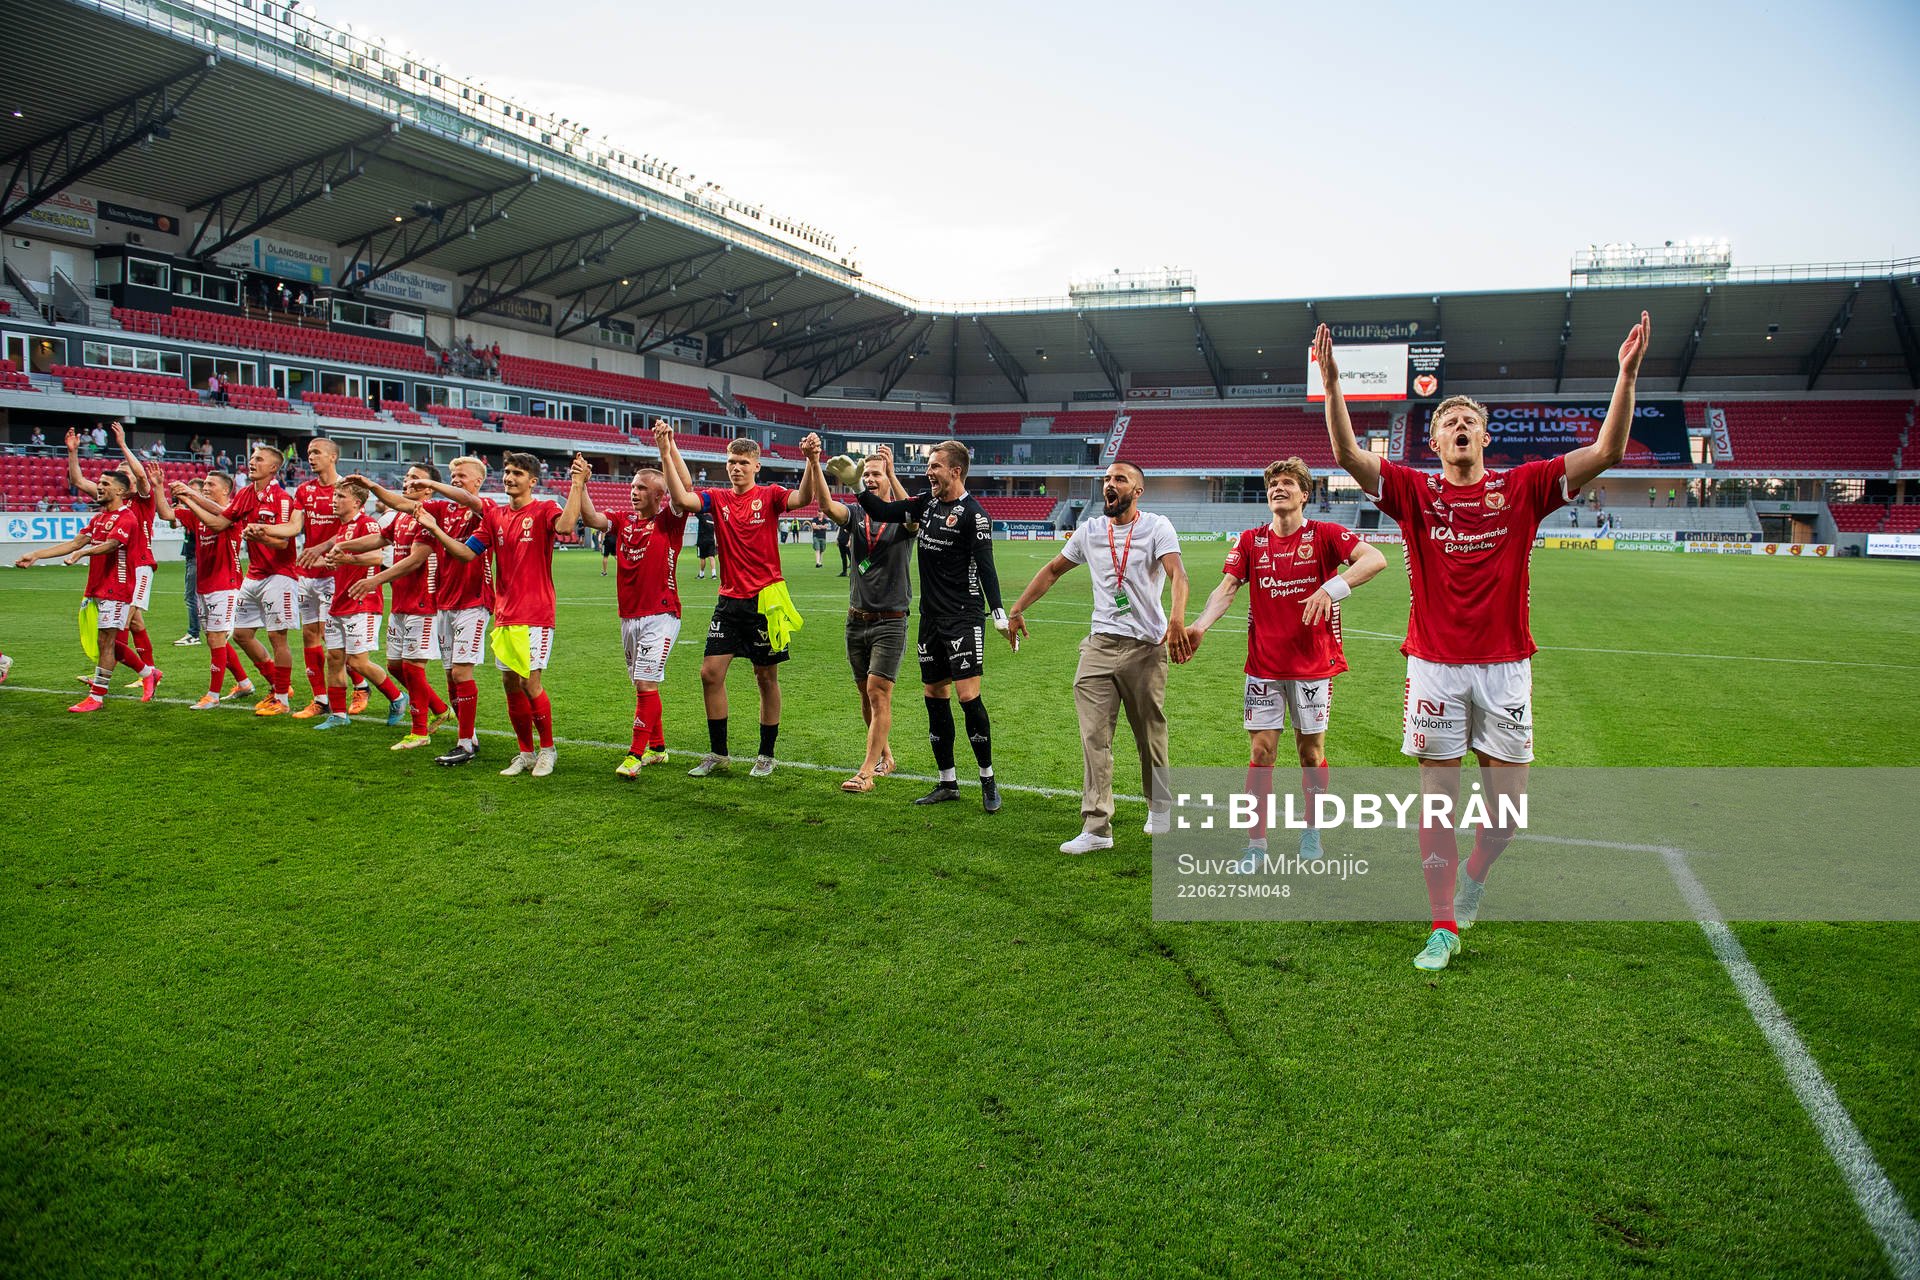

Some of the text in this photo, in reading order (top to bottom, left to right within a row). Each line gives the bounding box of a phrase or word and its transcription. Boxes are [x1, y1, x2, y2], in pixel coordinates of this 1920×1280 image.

[267, 243, 328, 264] ÖLANDSBLADET
[373, 281, 422, 300] Kalmar län
[1332, 325, 1408, 339] GuldFågeln
[1340, 370, 1387, 379] ellness
[1493, 408, 1538, 418] OCH
[1545, 407, 1665, 418] MOTGNG.
[1487, 422, 1538, 433] OCH
[1540, 421, 1594, 432] LUST.
[1365, 534, 1402, 544] elkedja
[1430, 526, 1508, 542] ICA Supermarket
[1445, 542, 1496, 553] Borgholm
[1560, 540, 1598, 549] EHRAB
[1259, 576, 1317, 588] ICA Supermarket
[1410, 714, 1453, 729] Nybloms
[1412, 732, 1426, 749] 39
